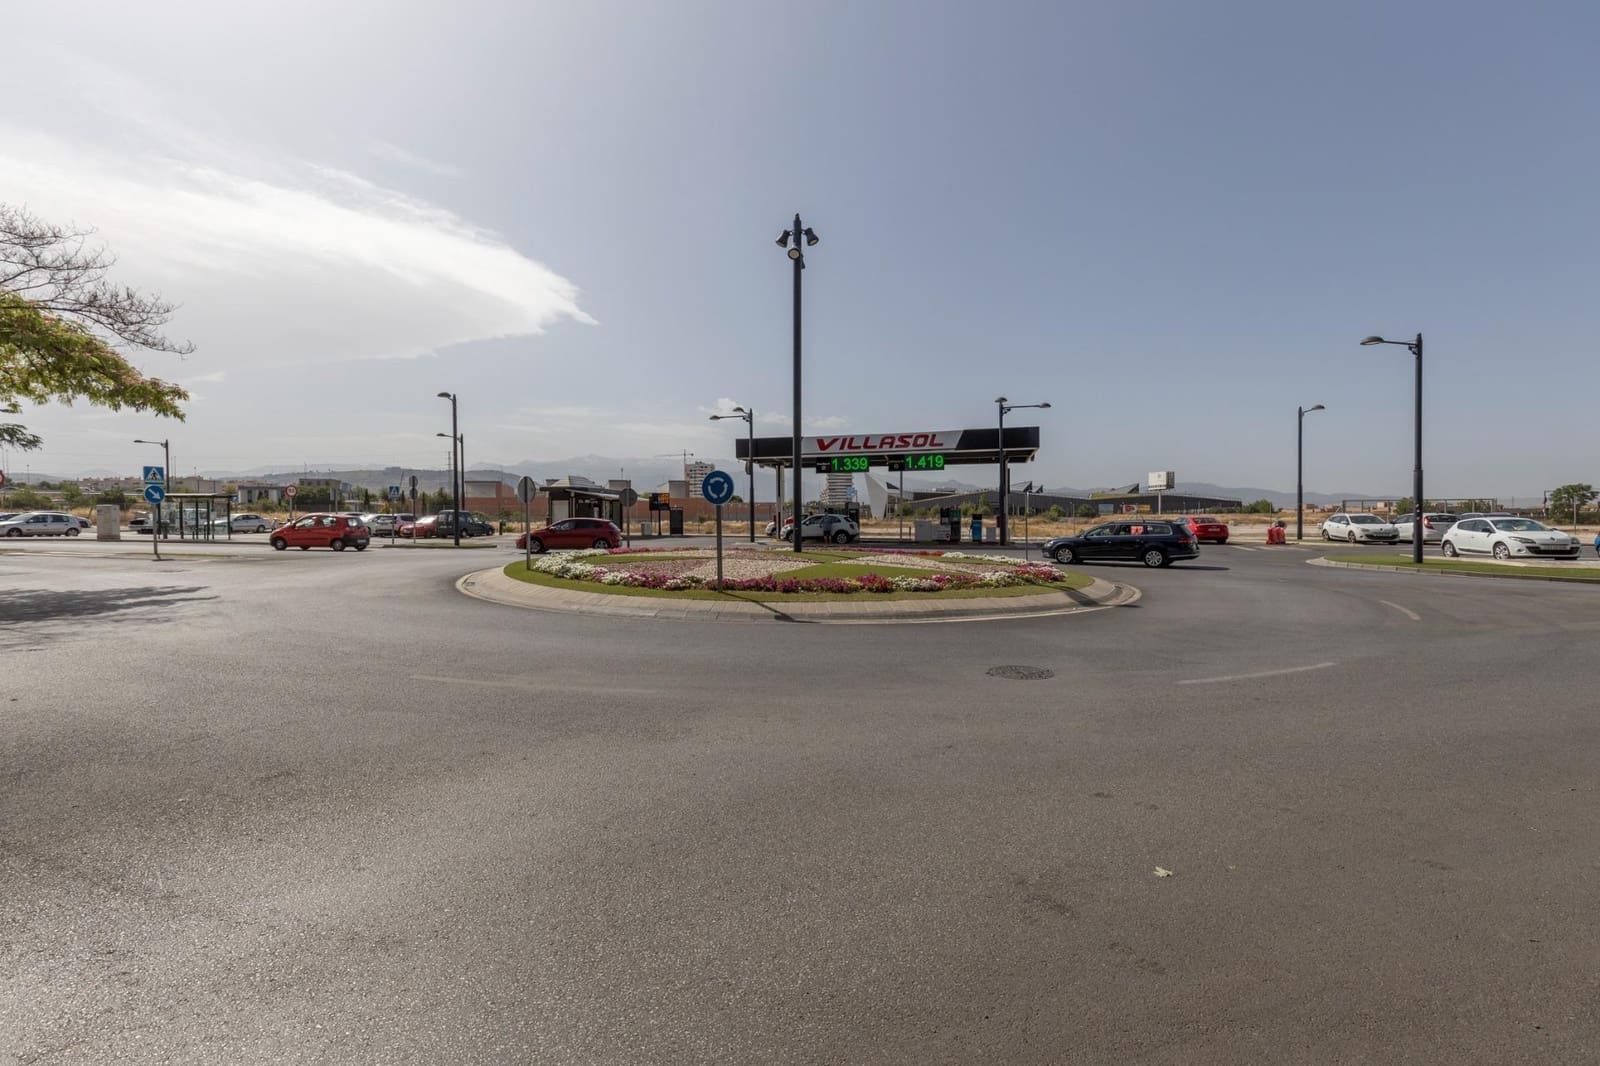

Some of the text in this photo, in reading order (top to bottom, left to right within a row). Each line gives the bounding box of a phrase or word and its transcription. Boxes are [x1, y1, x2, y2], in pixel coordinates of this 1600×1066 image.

[816, 434, 943, 451] VILLASOL
[832, 457, 868, 471] 1.339
[905, 455, 944, 469] 1.419
